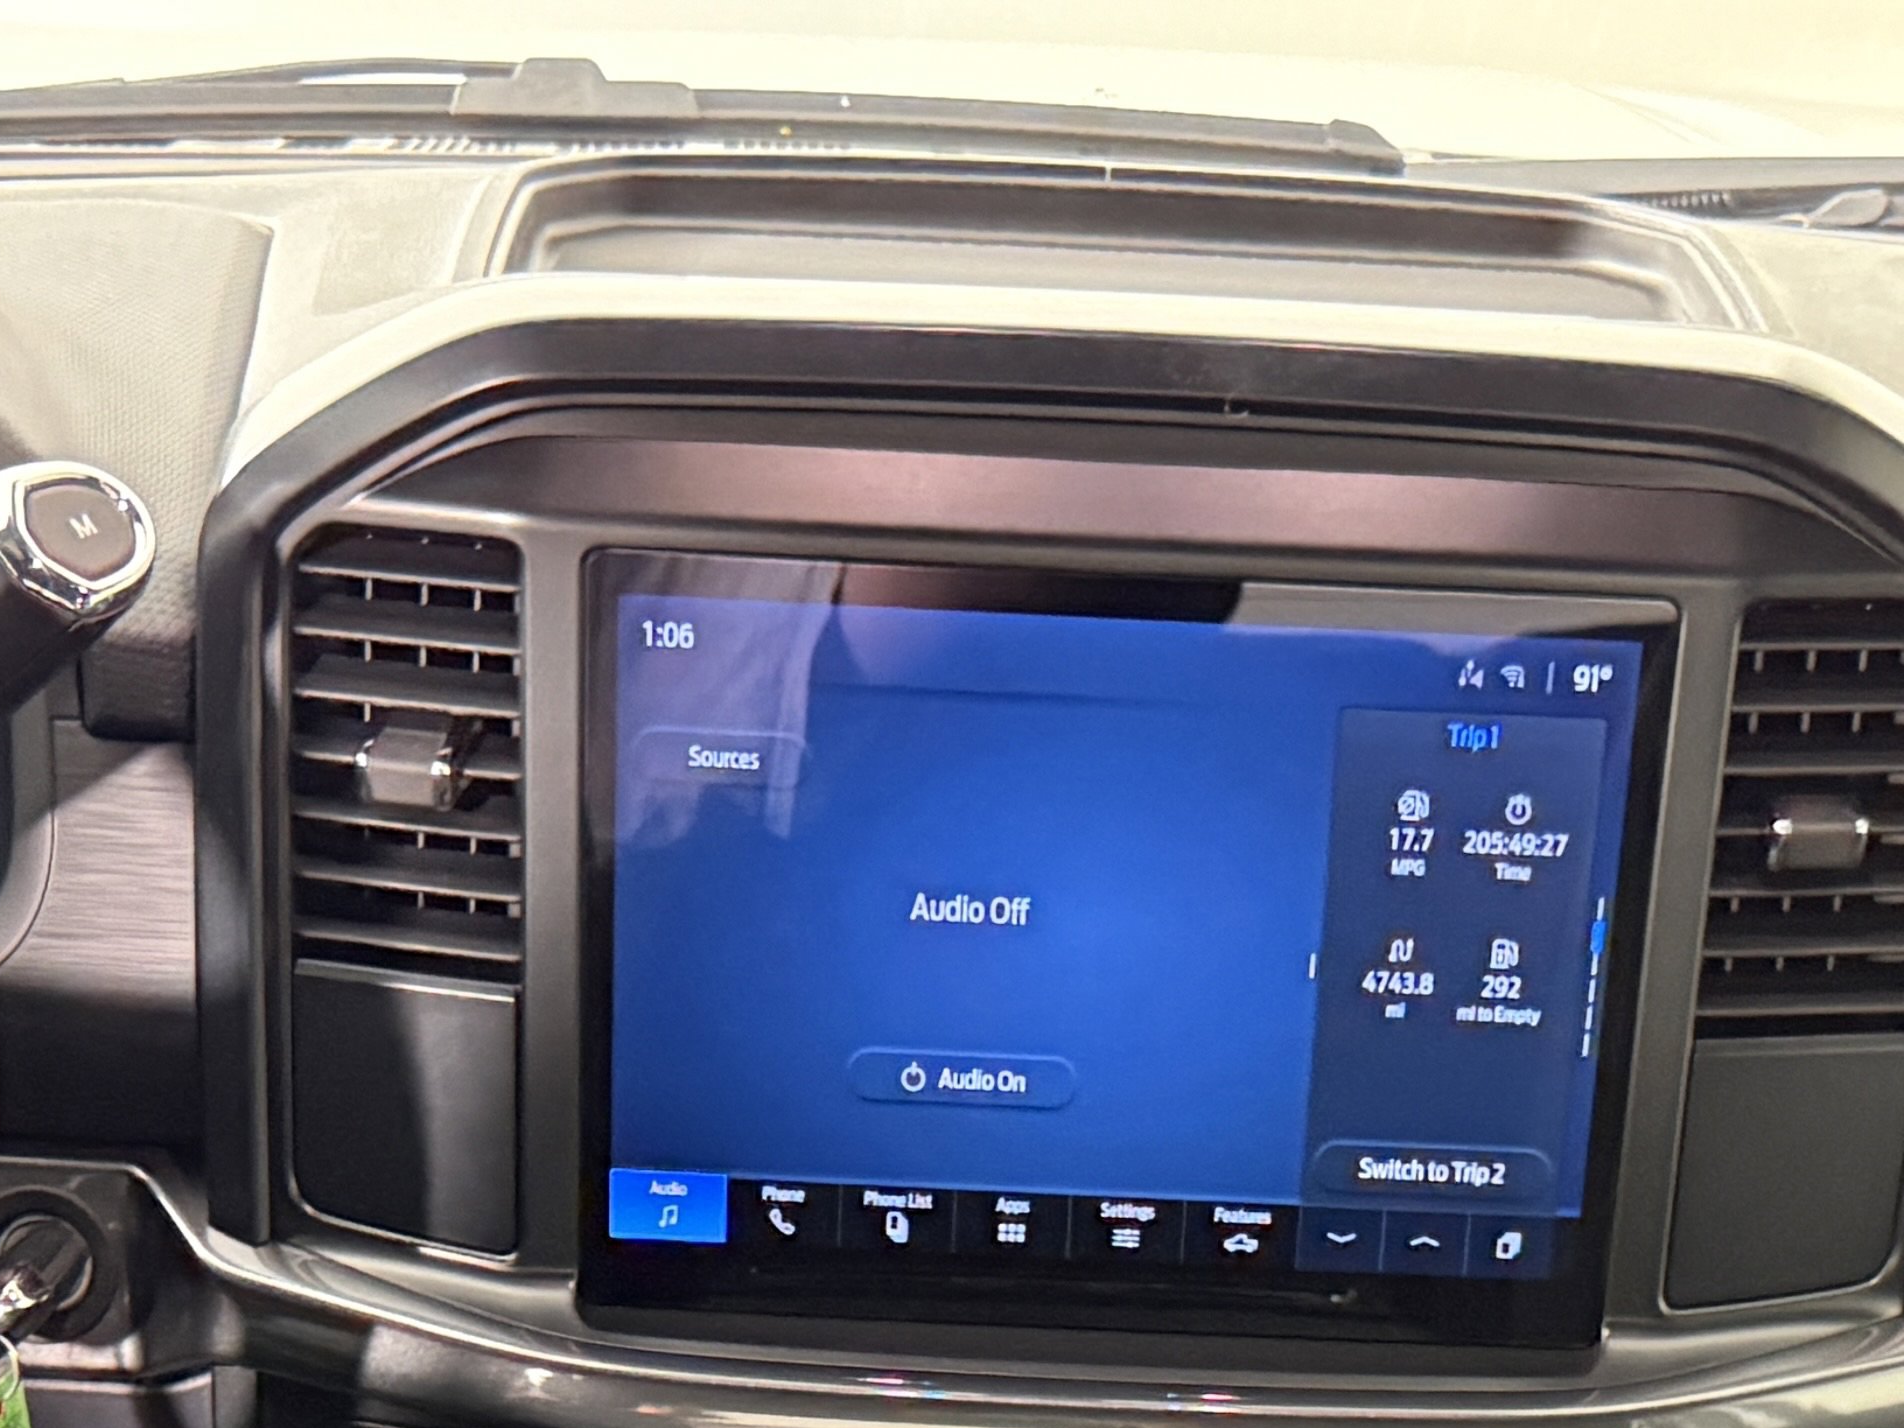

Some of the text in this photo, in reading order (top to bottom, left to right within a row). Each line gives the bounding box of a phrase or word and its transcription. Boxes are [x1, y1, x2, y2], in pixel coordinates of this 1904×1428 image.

[66, 513, 100, 539] M
[642, 620, 695, 649] 1:06
[1448, 723, 1500, 754] Trip 1
[688, 744, 760, 770] Sources
[1389, 827, 1434, 851] 17.7
[1462, 830, 1570, 857] 205:49:27
[1390, 858, 1426, 877] MPG
[1495, 862, 1532, 881] Time
[909, 892, 1032, 926] Audio Off
[1361, 970, 1434, 996] 4743.8
[1480, 975, 1522, 999] 292
[1385, 1002, 1406, 1019] mi
[1455, 1005, 1542, 1027] mi to Empty
[937, 1067, 1027, 1093] Audio On
[1357, 1156, 1506, 1187] Switch to Trip 2
[649, 1180, 688, 1197] Audio
[761, 1185, 806, 1203] Phone
[863, 1190, 934, 1210] Phone List
[995, 1197, 1031, 1215] Apps
[1100, 1202, 1156, 1222] Settings
[1213, 1206, 1273, 1225] Features
